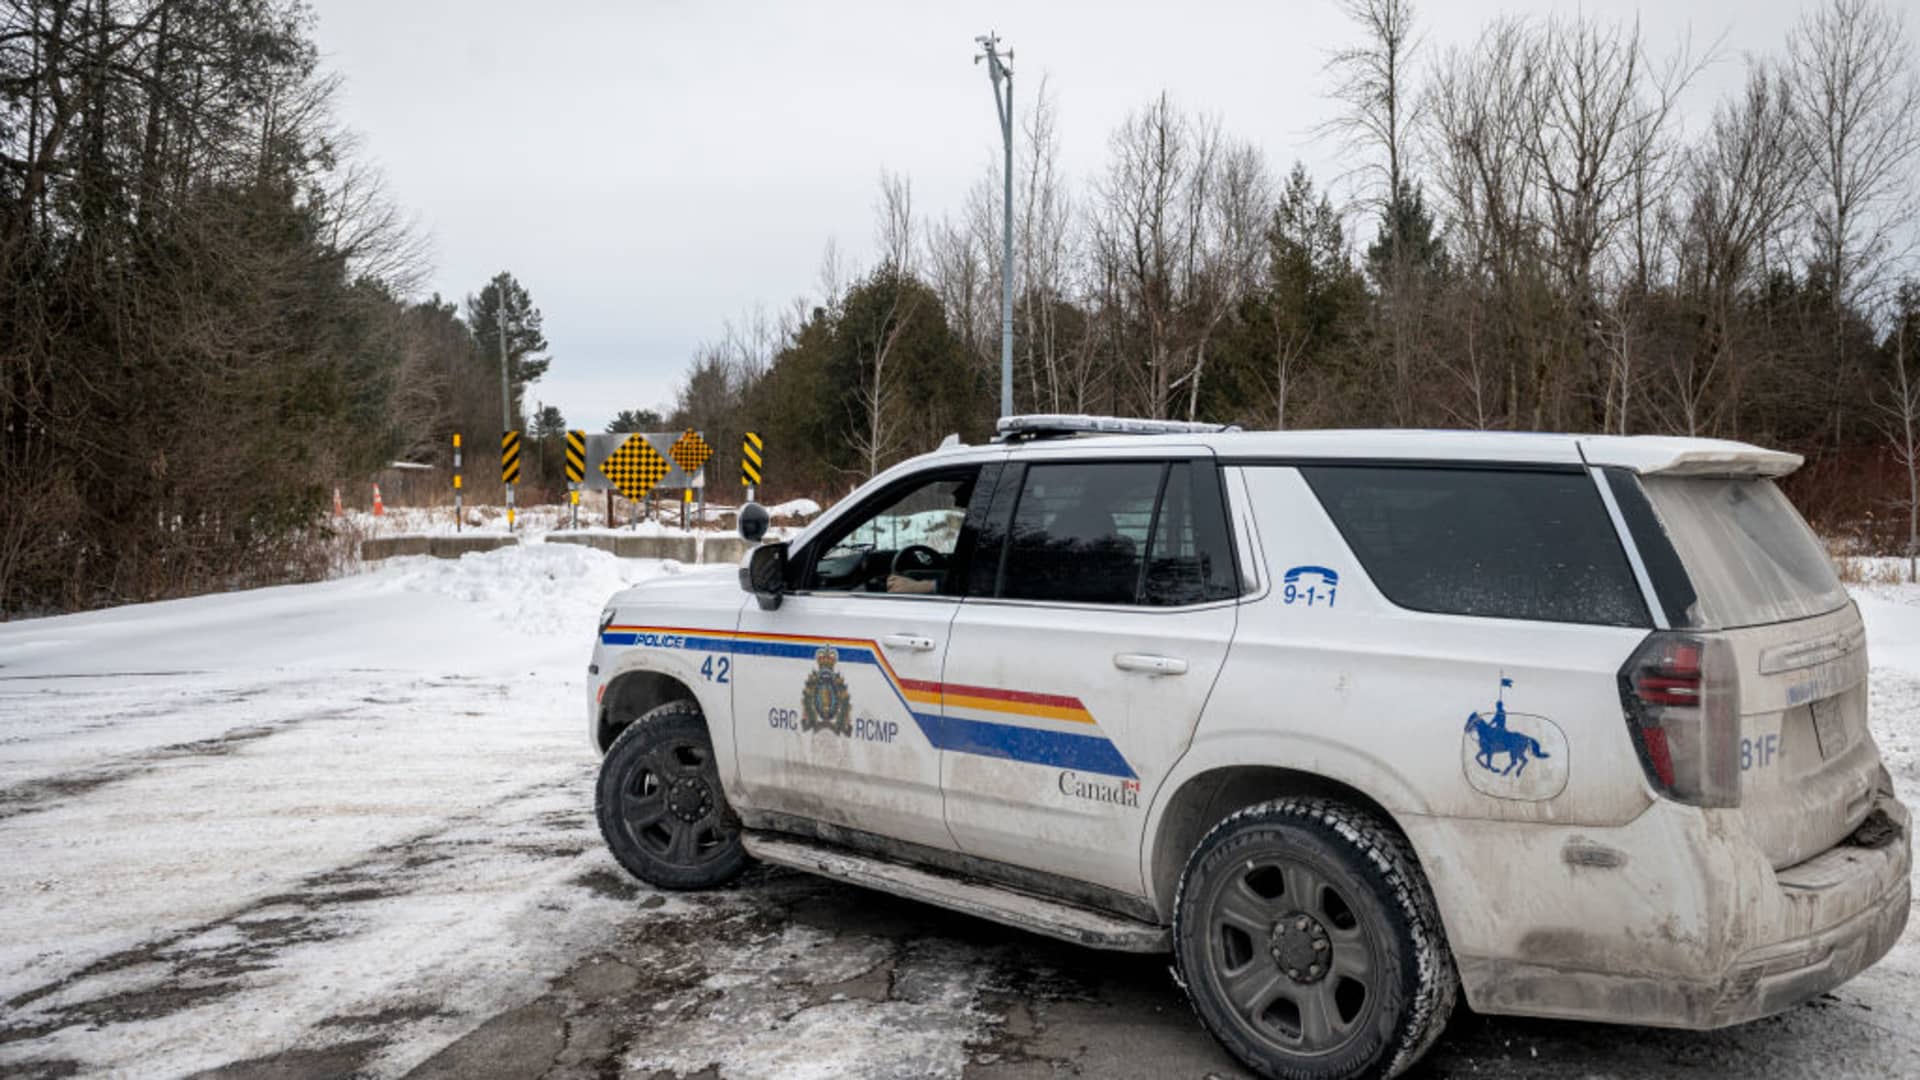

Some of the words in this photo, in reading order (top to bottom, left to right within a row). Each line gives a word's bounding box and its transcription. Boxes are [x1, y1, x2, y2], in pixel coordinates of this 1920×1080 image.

[1284, 584, 1336, 607] 9-1-1
[634, 633, 684, 648] POLICE
[701, 654, 729, 683] 42
[768, 707, 798, 731] GRC
[855, 718, 899, 744] RCMP
[1058, 770, 1139, 808] Canada
